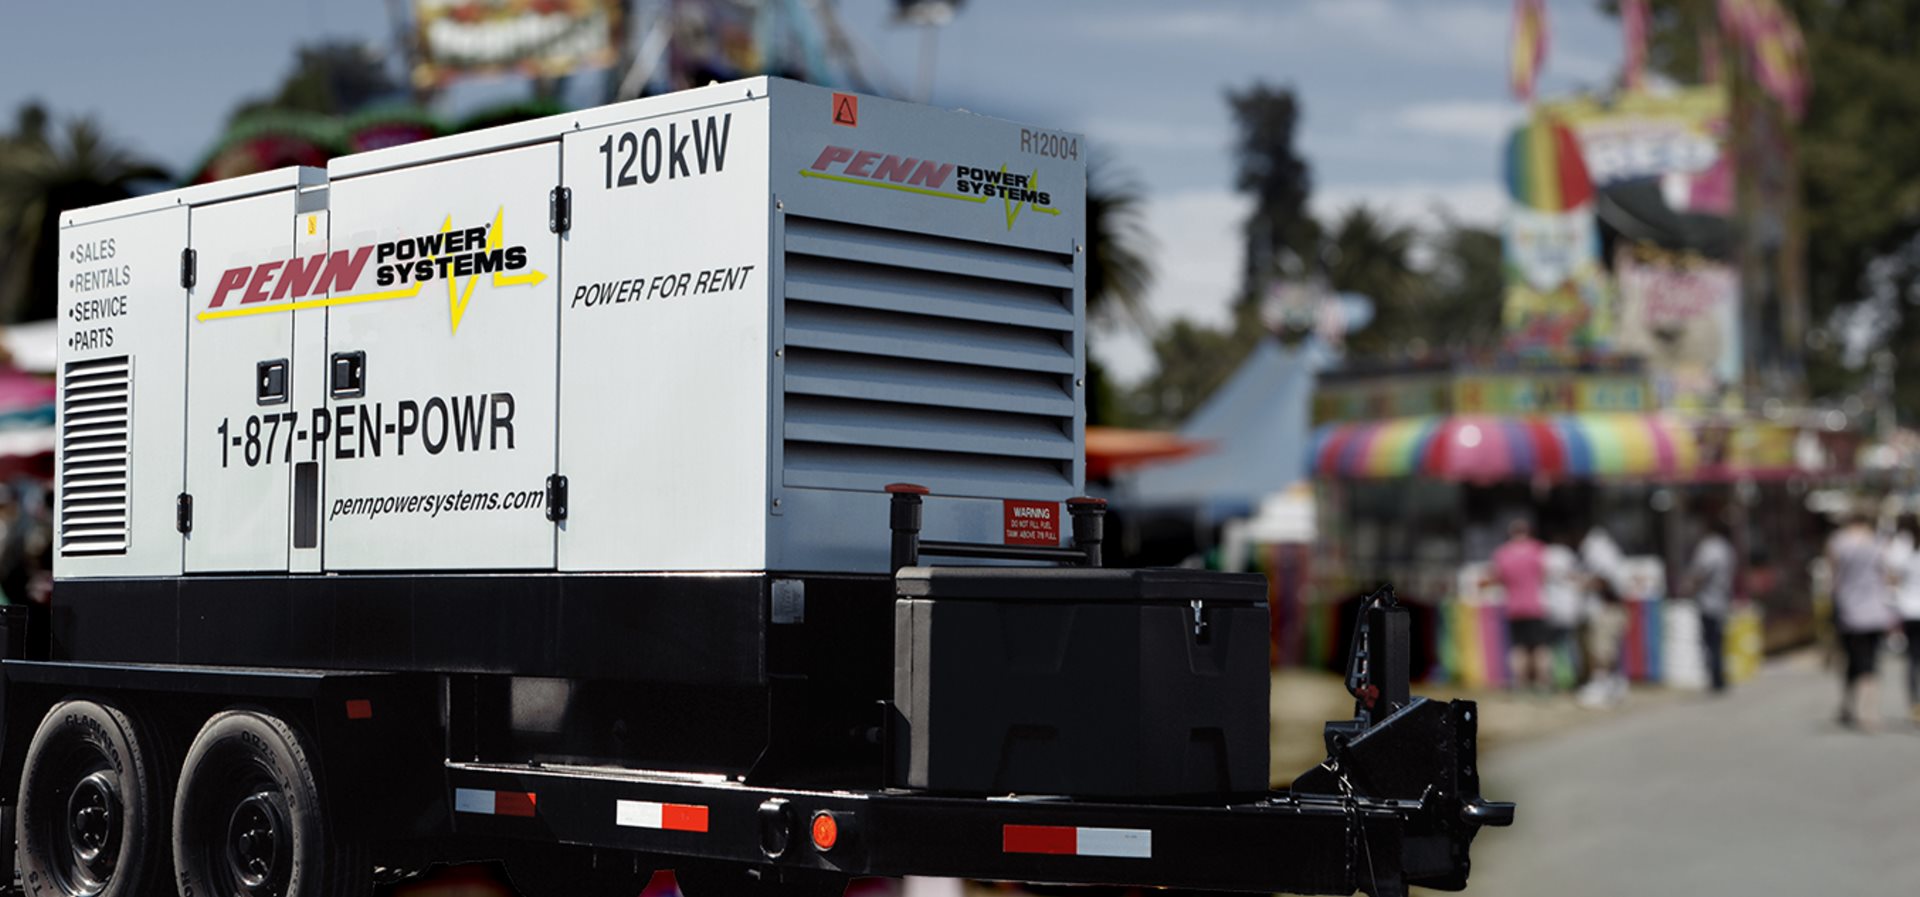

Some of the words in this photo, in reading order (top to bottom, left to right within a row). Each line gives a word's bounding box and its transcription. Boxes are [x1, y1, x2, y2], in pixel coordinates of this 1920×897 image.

[1020, 128, 1078, 161] R12004
[811, 145, 954, 188] PENN
[957, 165, 1028, 188] POWER
[957, 178, 1051, 205] SYSTEMS
[377, 226, 487, 264] POWER
[208, 244, 375, 308] PENN
[376, 245, 527, 287] SYSTEMS
[571, 278, 645, 308] POWER
[646, 272, 691, 300] FOR
[693, 265, 755, 295] RENT
[217, 392, 516, 468] 1-877-PEN-POWR
[329, 488, 545, 521] pennpowersystems.com
[1013, 507, 1051, 519] WARNING
